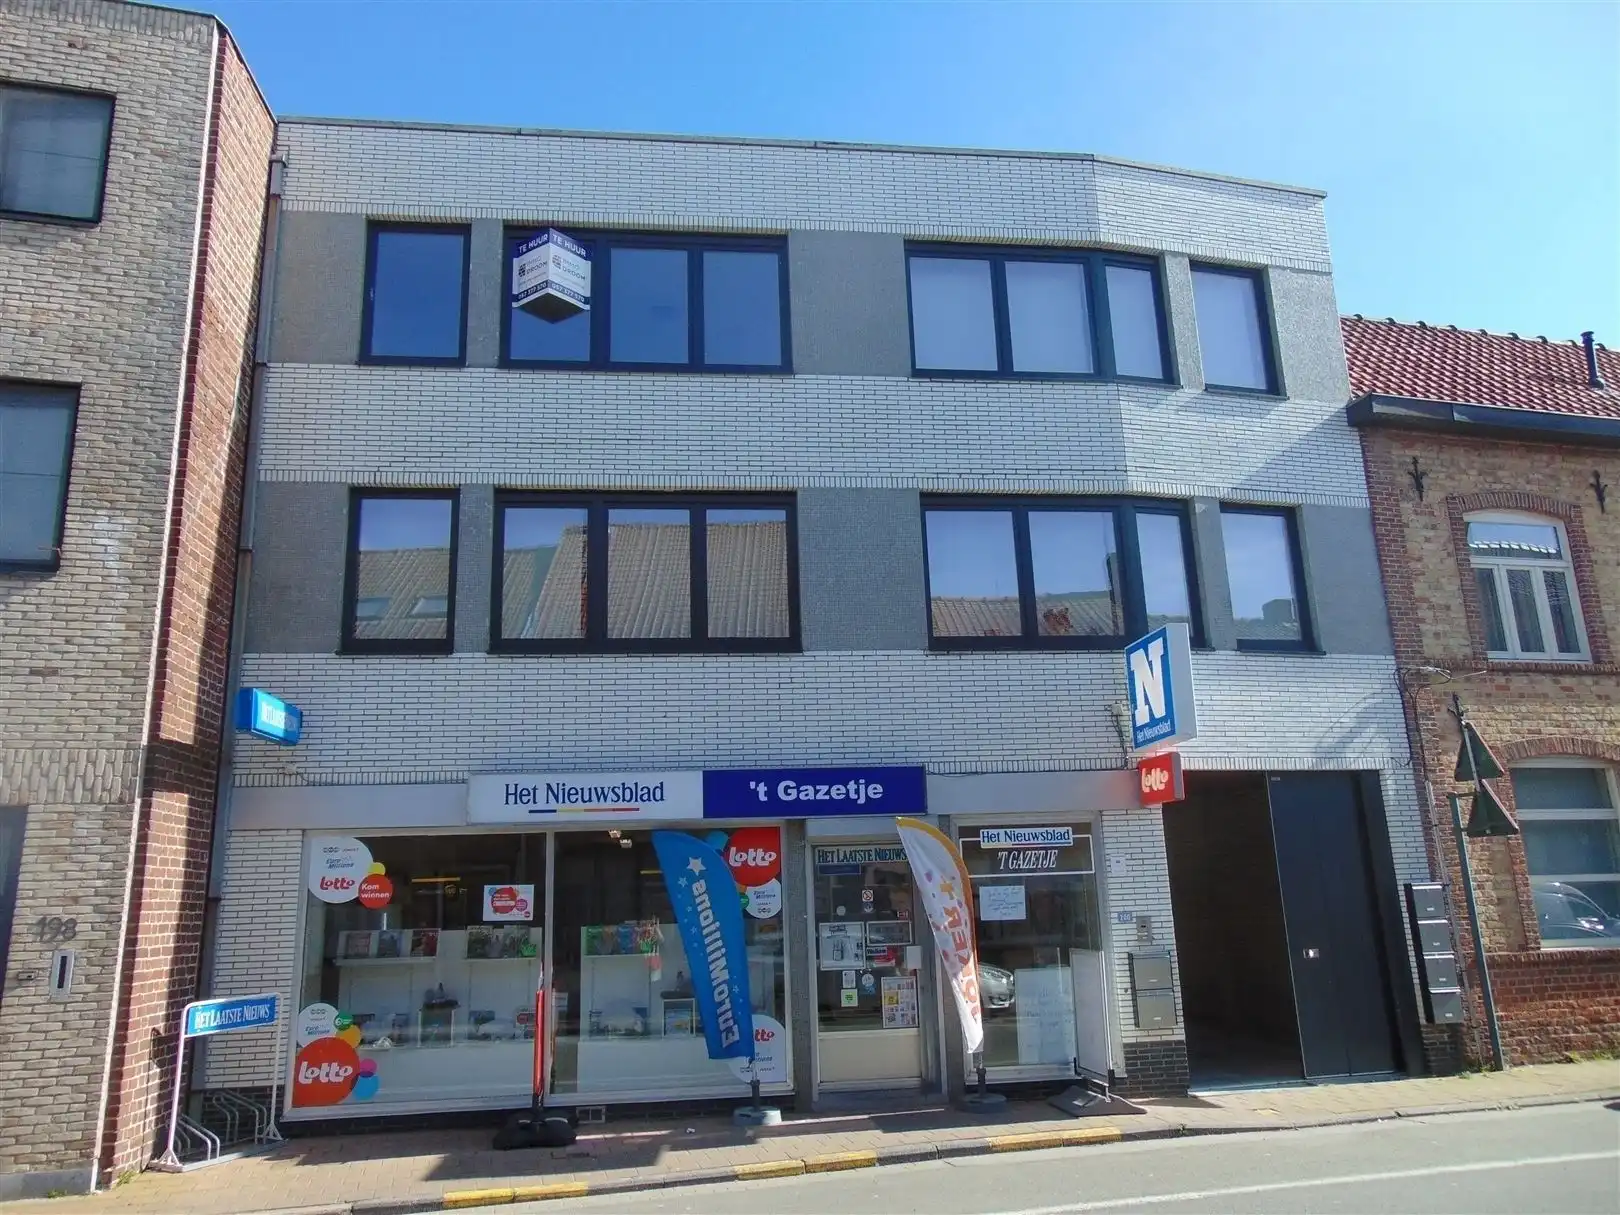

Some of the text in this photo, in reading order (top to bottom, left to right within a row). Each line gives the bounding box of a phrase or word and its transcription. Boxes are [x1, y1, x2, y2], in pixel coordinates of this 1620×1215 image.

[519, 233, 548, 254] TE HUUR
[552, 233, 586, 257] TE HUUR
[1130, 637, 1166, 727] N
[1144, 718, 1171, 741] Nieuwsblad
[504, 781, 665, 805] Het Nieuwsblad
[749, 779, 884, 804] 't Gazetje
[981, 828, 1070, 843] Het Nieuwsblad
[817, 847, 908, 863] HET LAATSTE NIEUWS
[1008, 849, 1058, 870] GAZETJE
[38, 916, 77, 941] 198
[211, 1007, 242, 1027] LAATSTE
[243, 1004, 270, 1021] NIEUWS
[754, 1028, 775, 1042] tto
